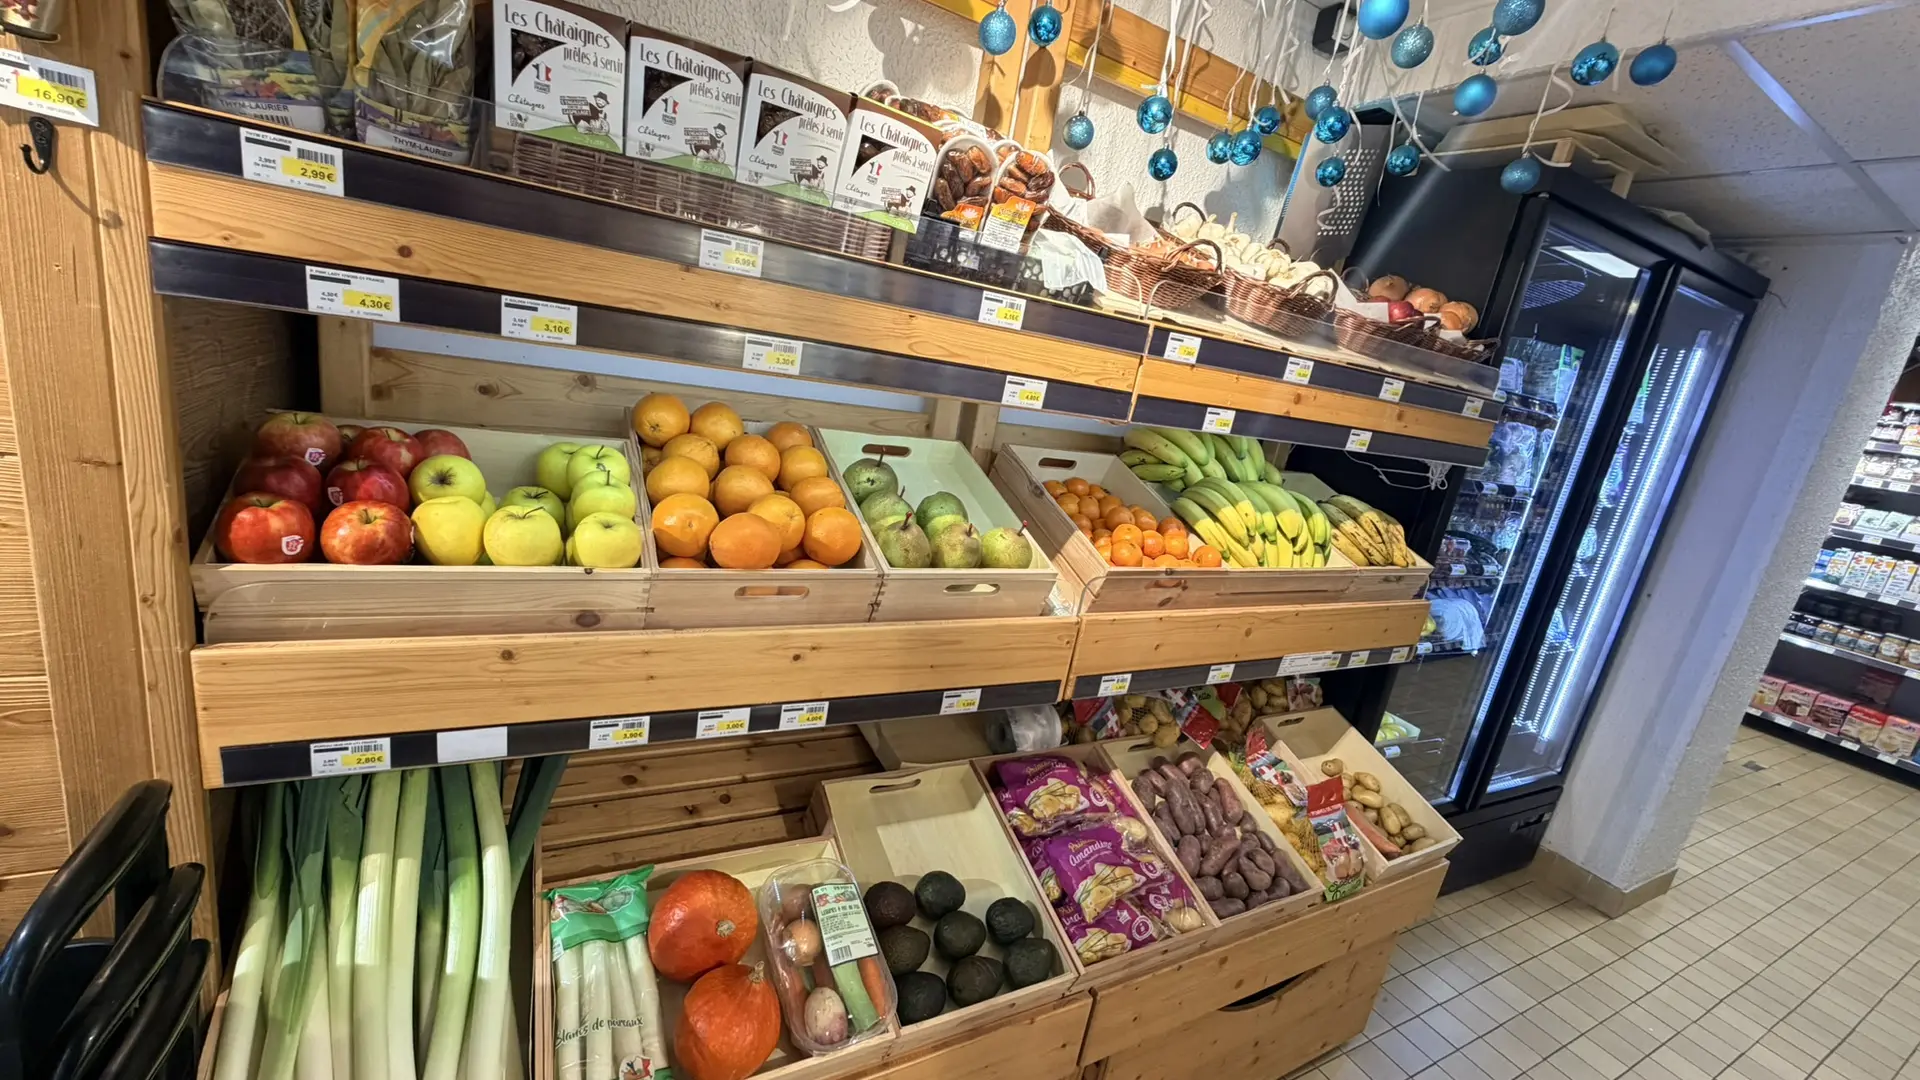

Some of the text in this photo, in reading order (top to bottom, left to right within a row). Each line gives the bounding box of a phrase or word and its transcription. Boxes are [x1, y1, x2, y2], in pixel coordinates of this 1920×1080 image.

[504, 3, 610, 49] Les Châtaignes
[563, 46, 590, 65] prêtes
[592, 52, 599, 68] à
[640, 43, 732, 84] Les Châtaignes
[33, 88, 86, 109] 16,90€
[689, 82, 714, 100] prêtes
[714, 87, 720, 101] à
[758, 79, 837, 121] Les Châtaignes
[219, 100, 290, 113] THYM-LAURIER
[798, 117, 819, 134] prêtes
[820, 123, 825, 136] à
[860, 115, 876, 134] Les
[392, 136, 454, 158] THYM-LAURIER
[300, 167, 335, 183] 2,99€
[359, 298, 391, 311] 4,30€
[543, 323, 571, 335] 3,10€
[356, 755, 384, 765] 2,80€
[591, 1017, 605, 1032] de
[607, 1016, 644, 1031] poireaux
